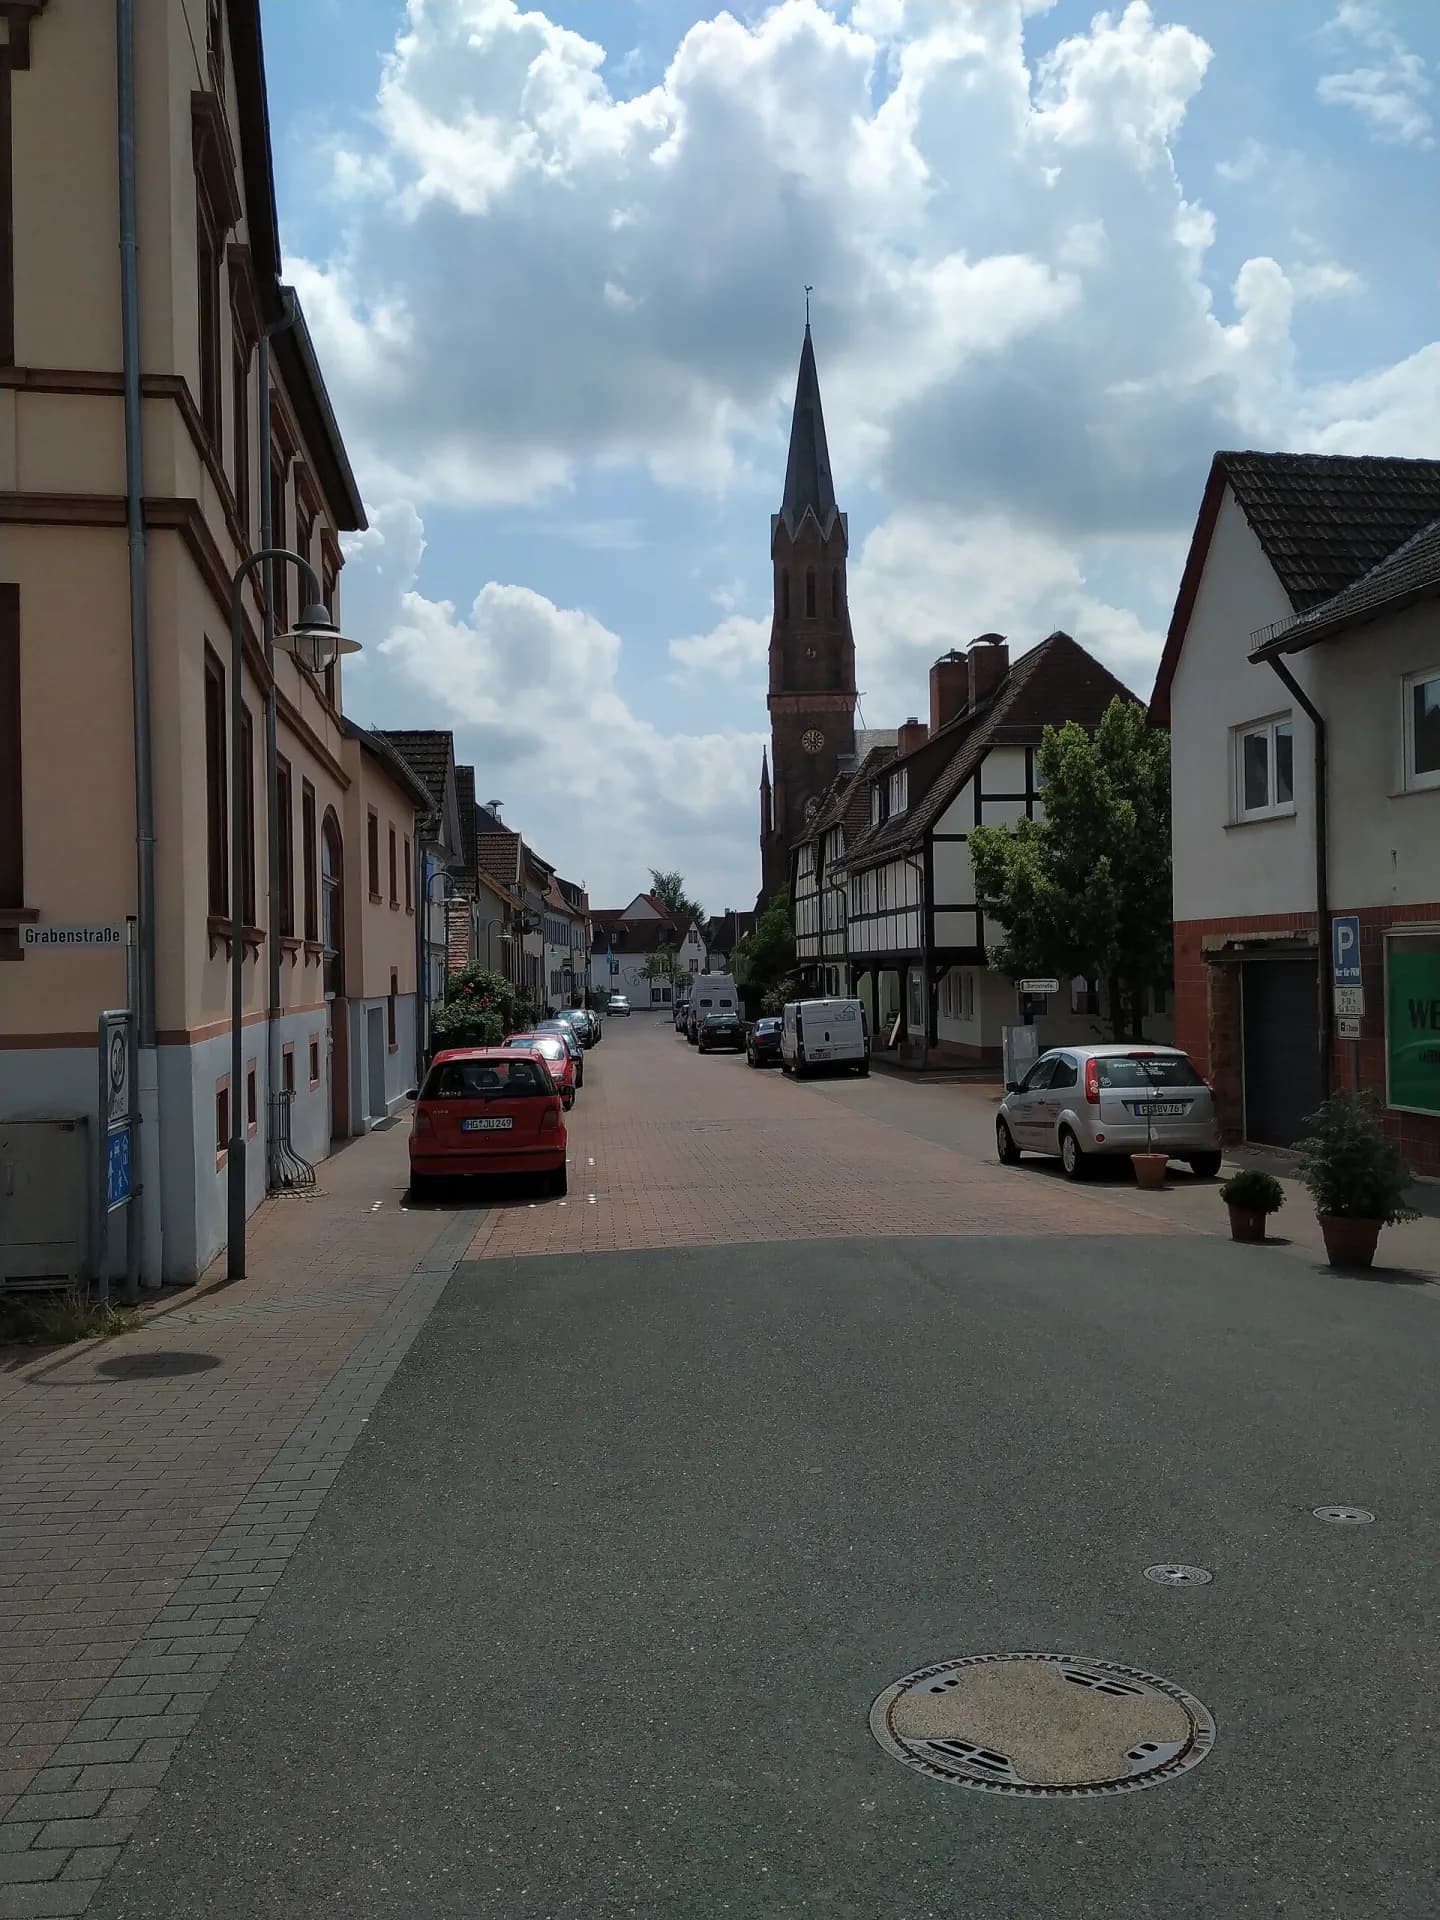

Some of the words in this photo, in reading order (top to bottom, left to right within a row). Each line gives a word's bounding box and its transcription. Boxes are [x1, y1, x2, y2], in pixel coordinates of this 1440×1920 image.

[25, 928, 120, 943] Grabenstraße
[1338, 926, 1354, 964] P
[113, 1048, 123, 1077] 30
[466, 1120, 478, 1129] HG
[483, 1120, 495, 1129] JU
[495, 1119, 512, 1128] 249
